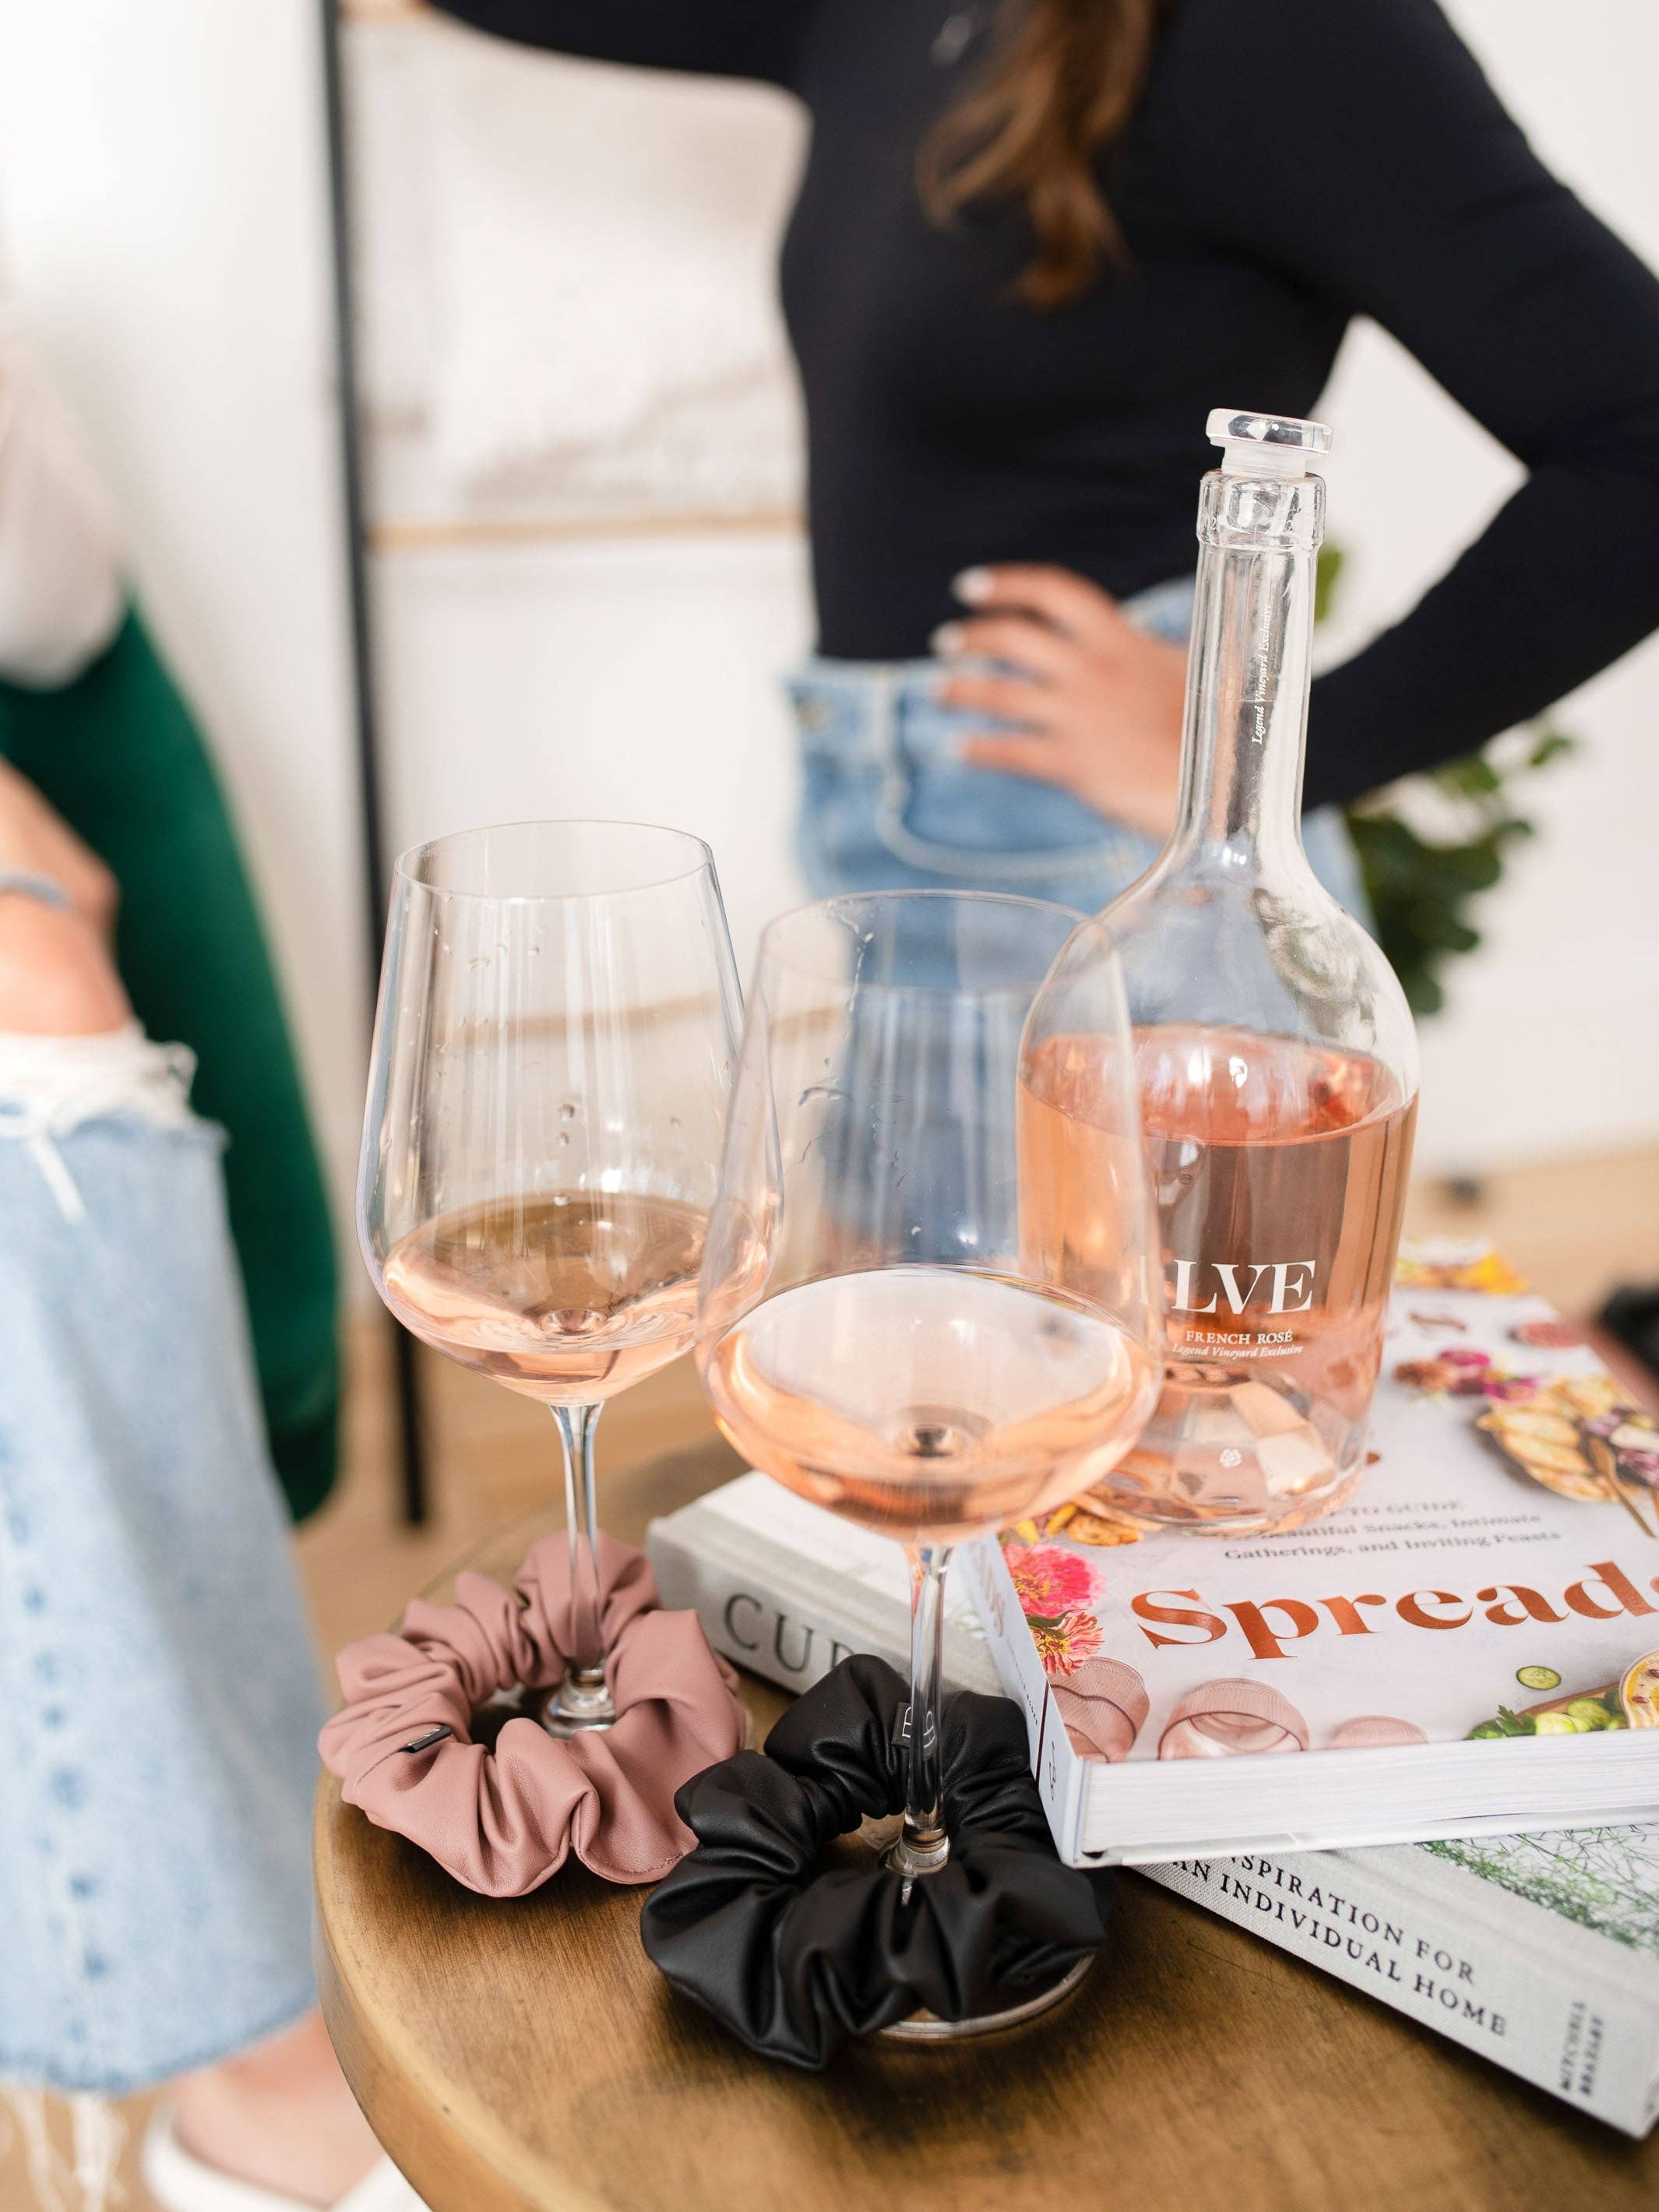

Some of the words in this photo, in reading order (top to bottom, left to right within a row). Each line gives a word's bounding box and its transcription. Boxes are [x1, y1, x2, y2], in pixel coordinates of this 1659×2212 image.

[1255, 653, 1269, 703] Vineyard
[1252, 704, 1265, 745] Legend
[1171, 1259, 1316, 1315] LVE
[1171, 1344, 1210, 1356] Legend
[1212, 1346, 1258, 1360] Vineyard
[1185, 1330, 1251, 1345] FRENCH
[1257, 1329, 1294, 1344] ROSÉ
[1451, 1513, 1542, 1528] Intimate
[1224, 1544, 1353, 1559] Gatherings,
[1358, 1540, 1399, 1553] and
[1404, 1535, 1492, 1550] Inviting
[1494, 1530, 1561, 1545] Feasts
[1131, 1560, 1659, 1661] Spread
[1220, 1873, 1401, 1982] INDIVIDUAL
[1414, 1973, 1507, 2037] HOME
[1415, 1938, 1474, 1985] FOR
